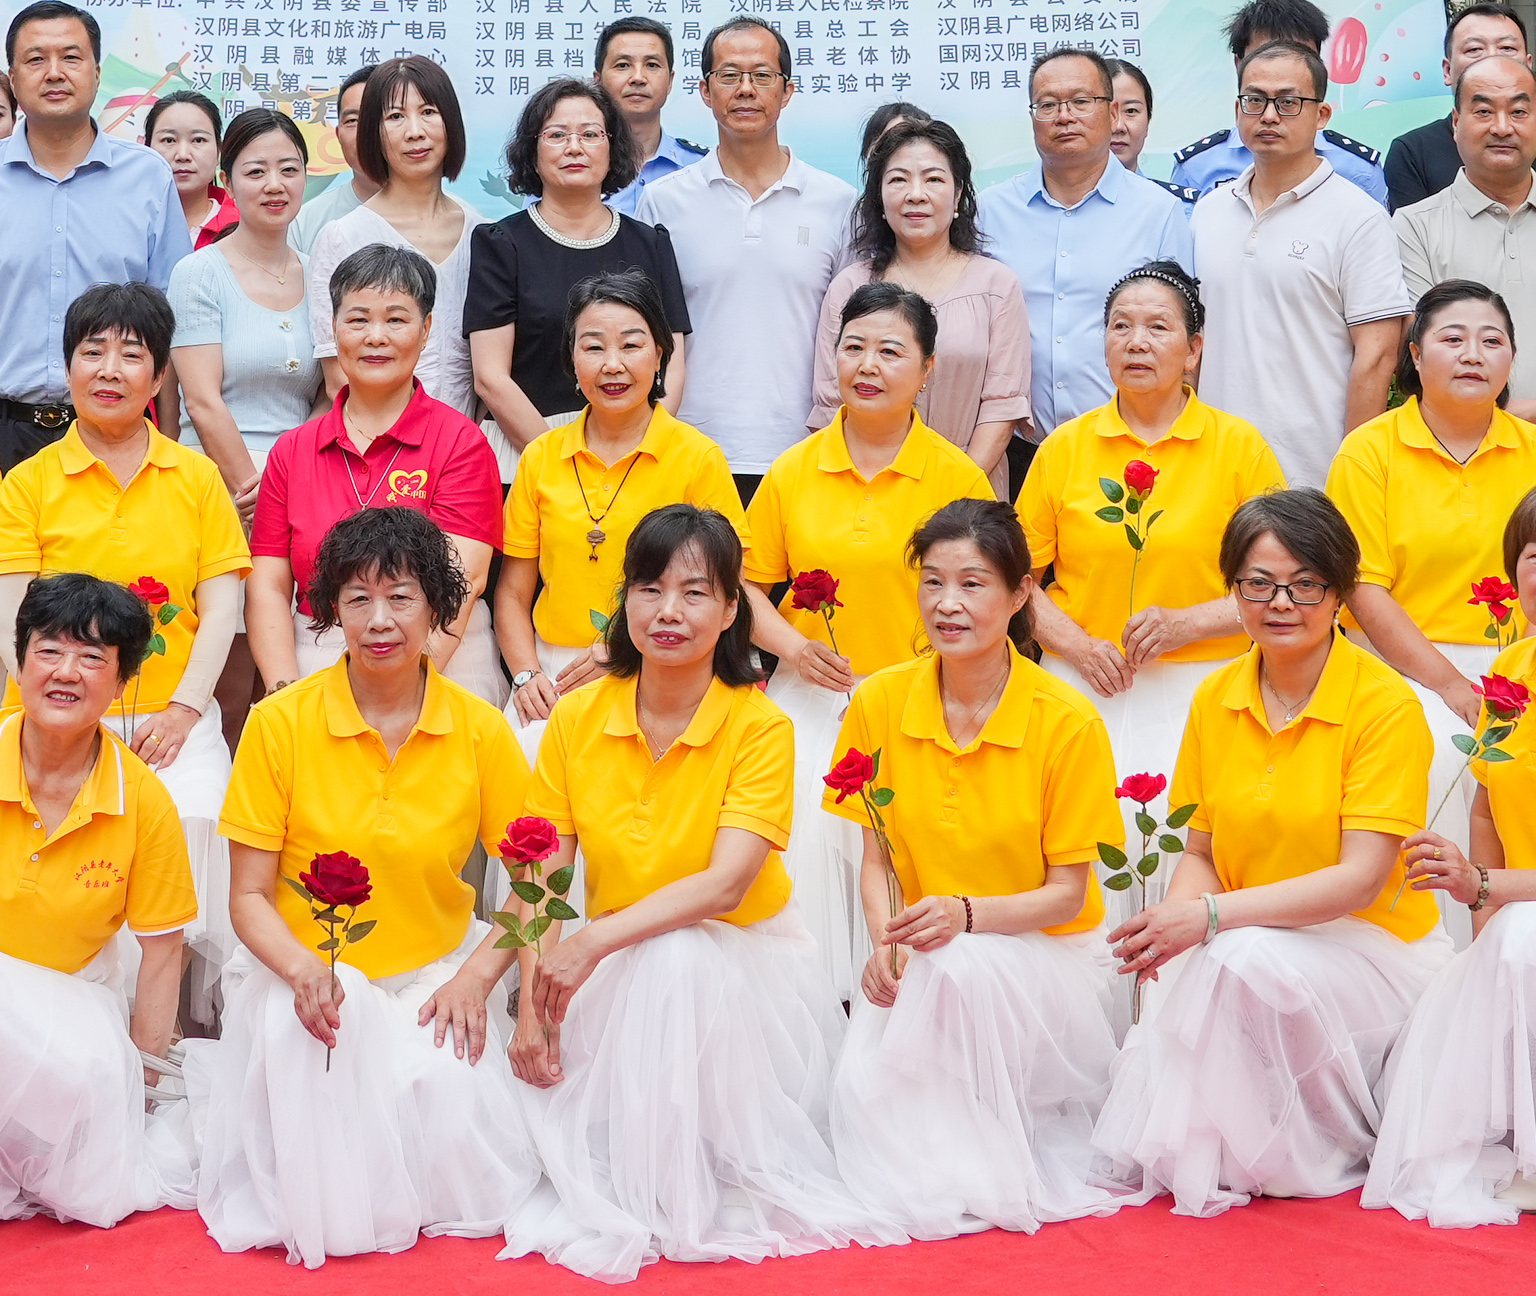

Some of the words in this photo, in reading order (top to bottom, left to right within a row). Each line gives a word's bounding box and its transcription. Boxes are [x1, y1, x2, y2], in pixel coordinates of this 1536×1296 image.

[194, 16, 447, 41] 汉阴县文化和旅游广电局
[937, 11, 1140, 36] 汉阴县广电网络公司
